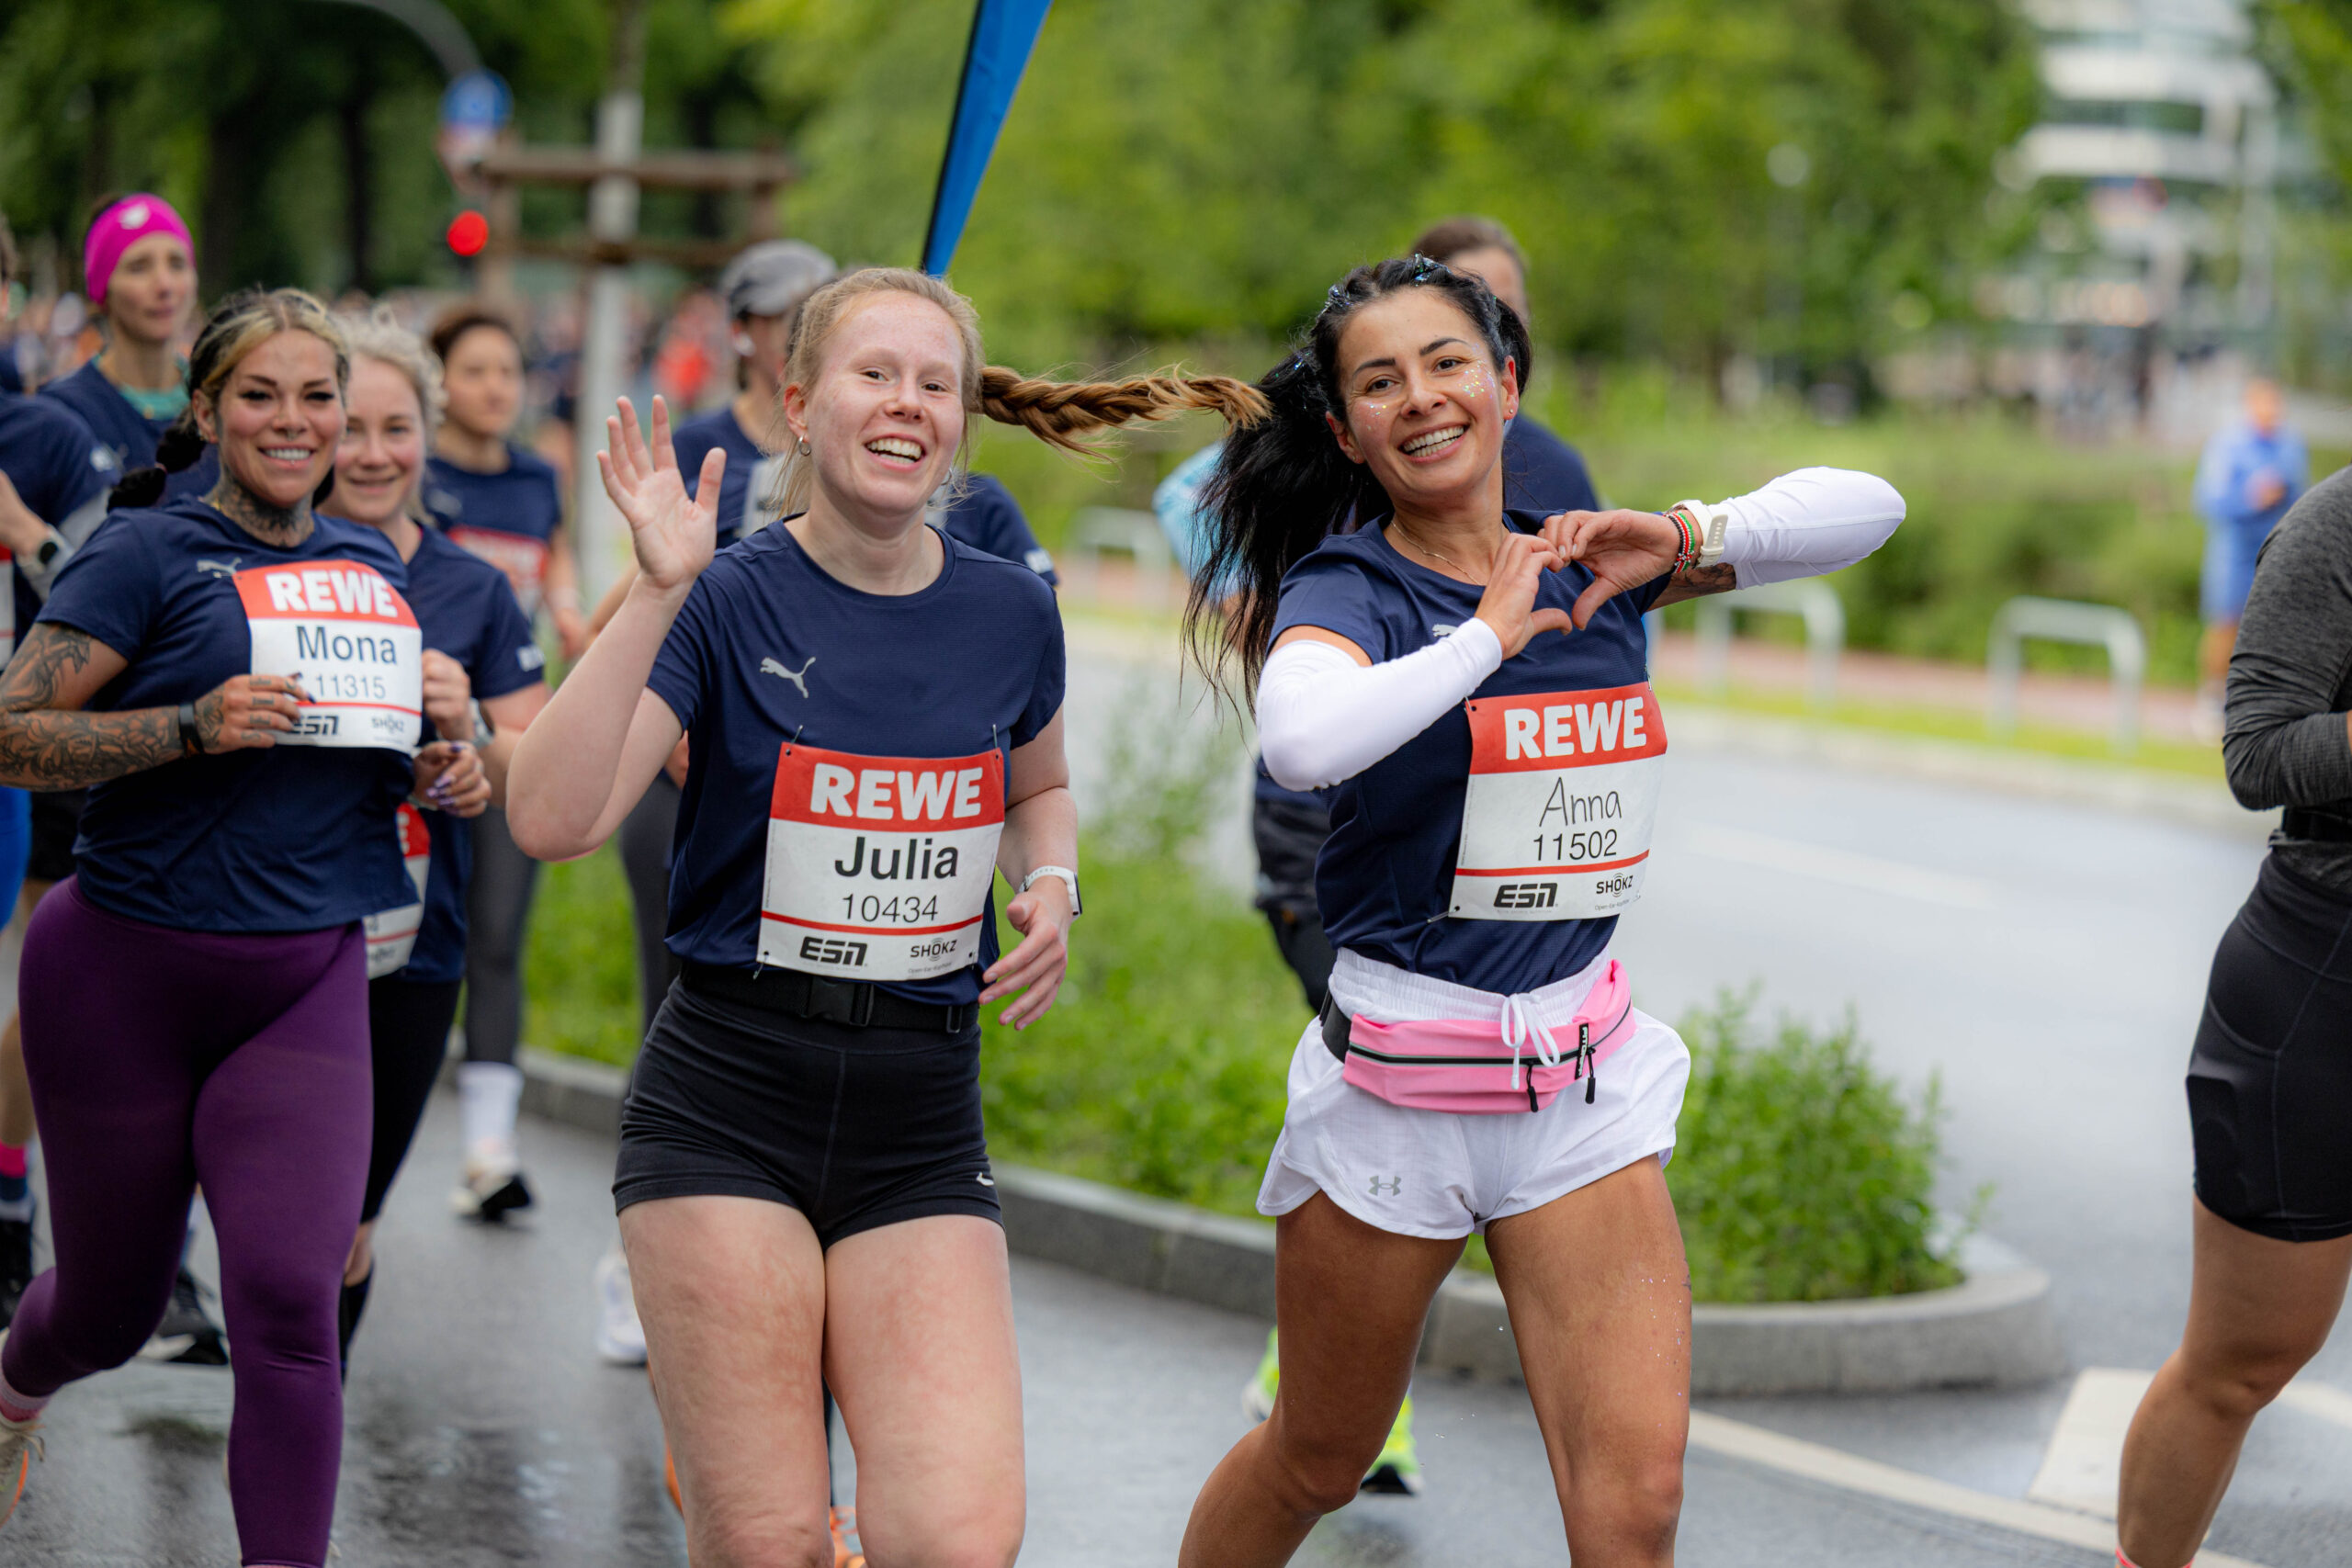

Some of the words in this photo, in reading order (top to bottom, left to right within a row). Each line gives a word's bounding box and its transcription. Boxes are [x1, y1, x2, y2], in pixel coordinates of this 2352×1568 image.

[265, 569, 398, 618] REWE
[296, 625, 397, 665] Mona
[316, 672, 386, 700] 11315
[1503, 695, 1647, 761] REWE
[809, 761, 983, 821] REWE
[1538, 775, 1623, 828] Anna
[834, 836, 958, 880] Julia
[1532, 829, 1618, 862] 11502
[1492, 882, 1558, 908] ESN
[1595, 874, 1634, 896] SHOKZ
[842, 893, 939, 923] 10434
[799, 935, 868, 966] ESN
[910, 938, 958, 959] SHOKZ
